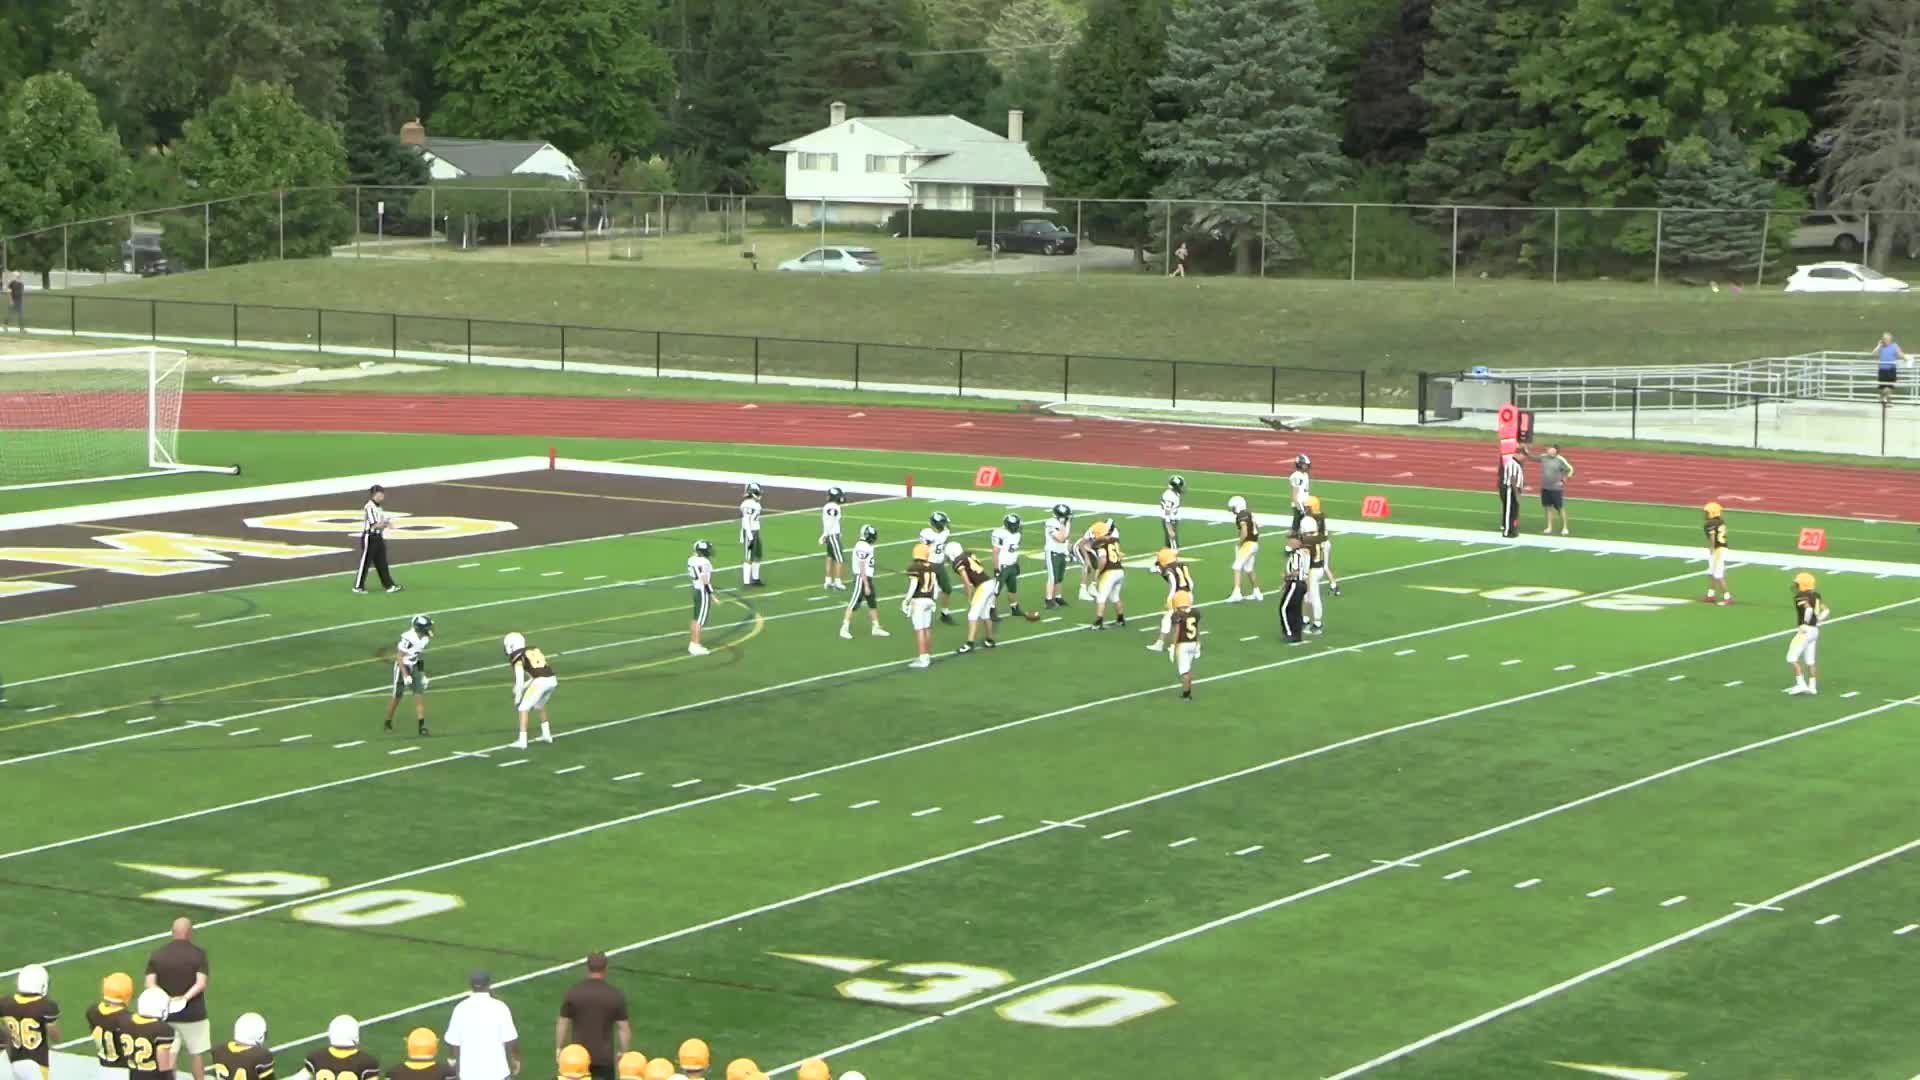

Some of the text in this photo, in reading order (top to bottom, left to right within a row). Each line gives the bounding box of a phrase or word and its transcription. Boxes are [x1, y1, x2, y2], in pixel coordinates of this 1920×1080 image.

[1185, 617, 1197, 640] 5
[139, 870, 467, 926] 20
[833, 962, 1179, 1028] 30
